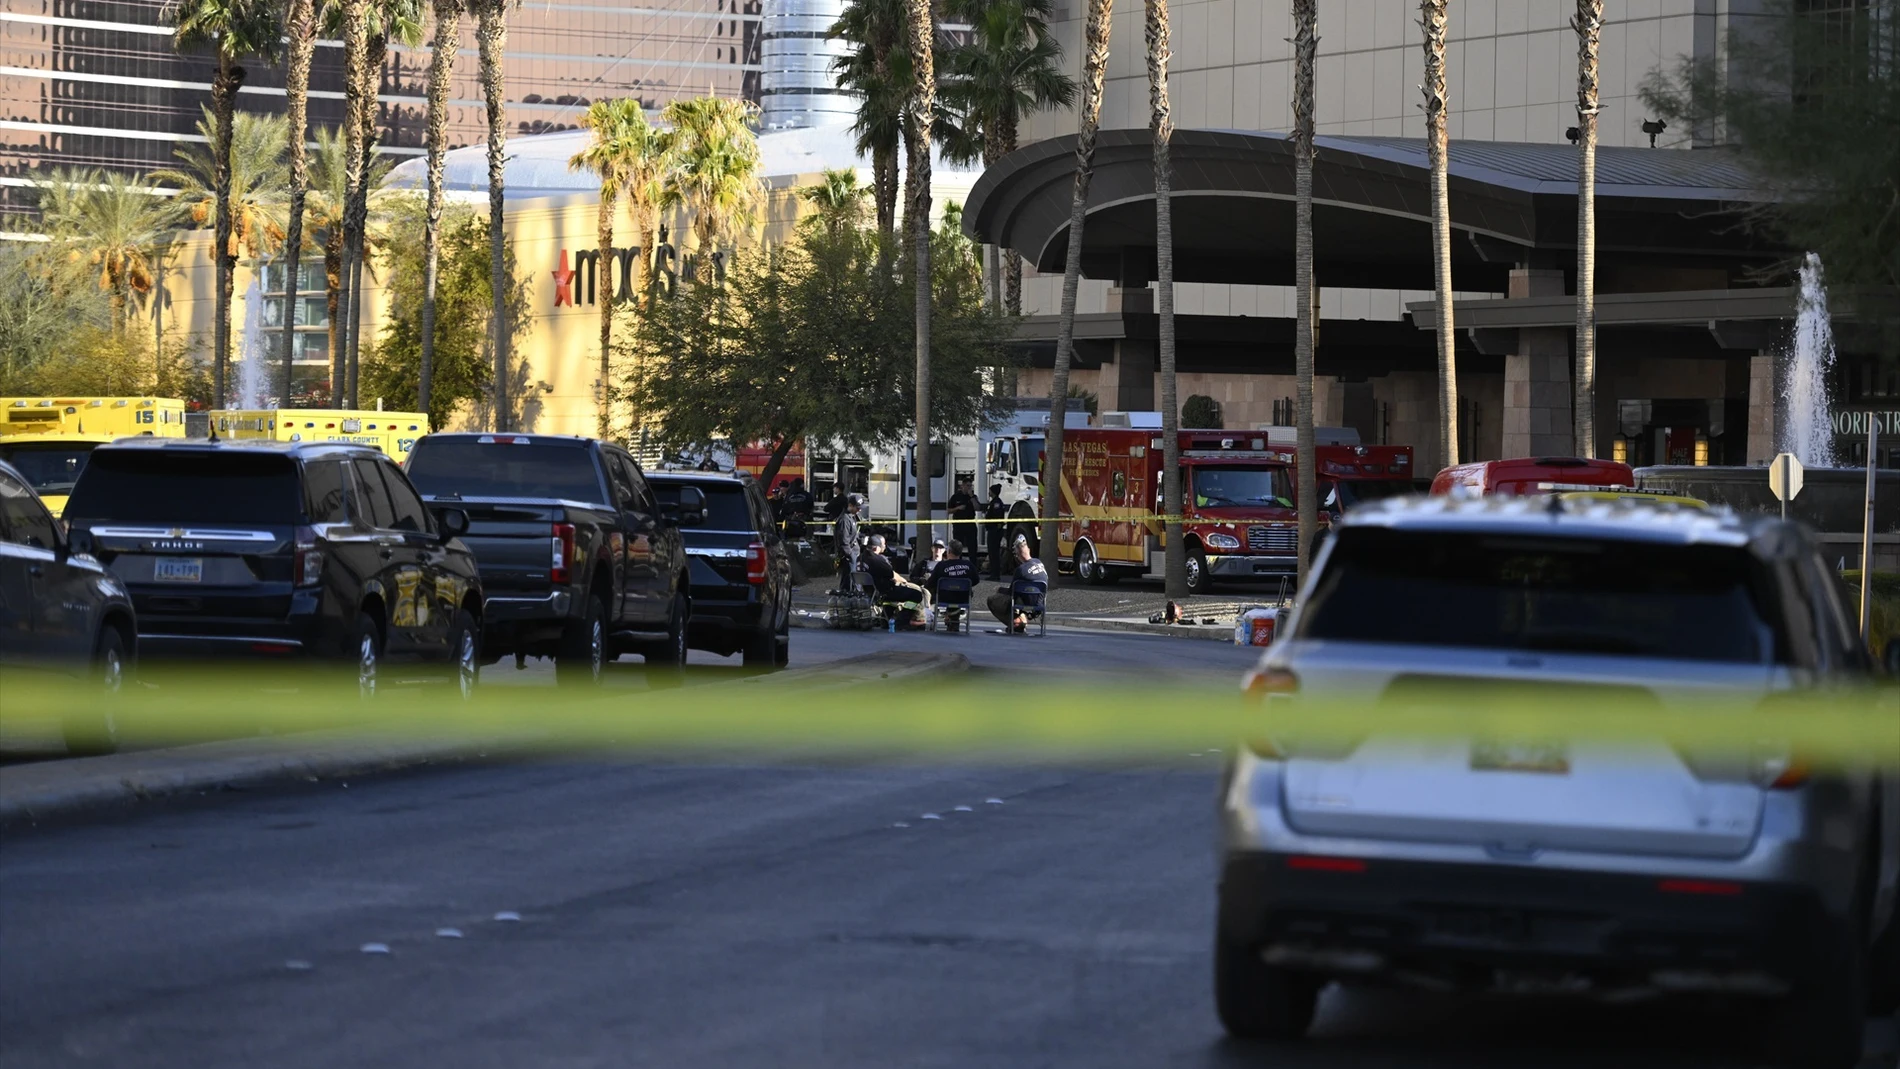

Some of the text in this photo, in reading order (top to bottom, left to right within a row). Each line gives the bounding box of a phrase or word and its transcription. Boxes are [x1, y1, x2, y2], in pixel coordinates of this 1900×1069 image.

[135, 410, 154, 424] 15
[352, 436, 380, 444] COUNTY
[397, 438, 416, 453] 12
[1062, 441, 1108, 454] LAS VEGAS
[151, 541, 203, 549] TAHOE
